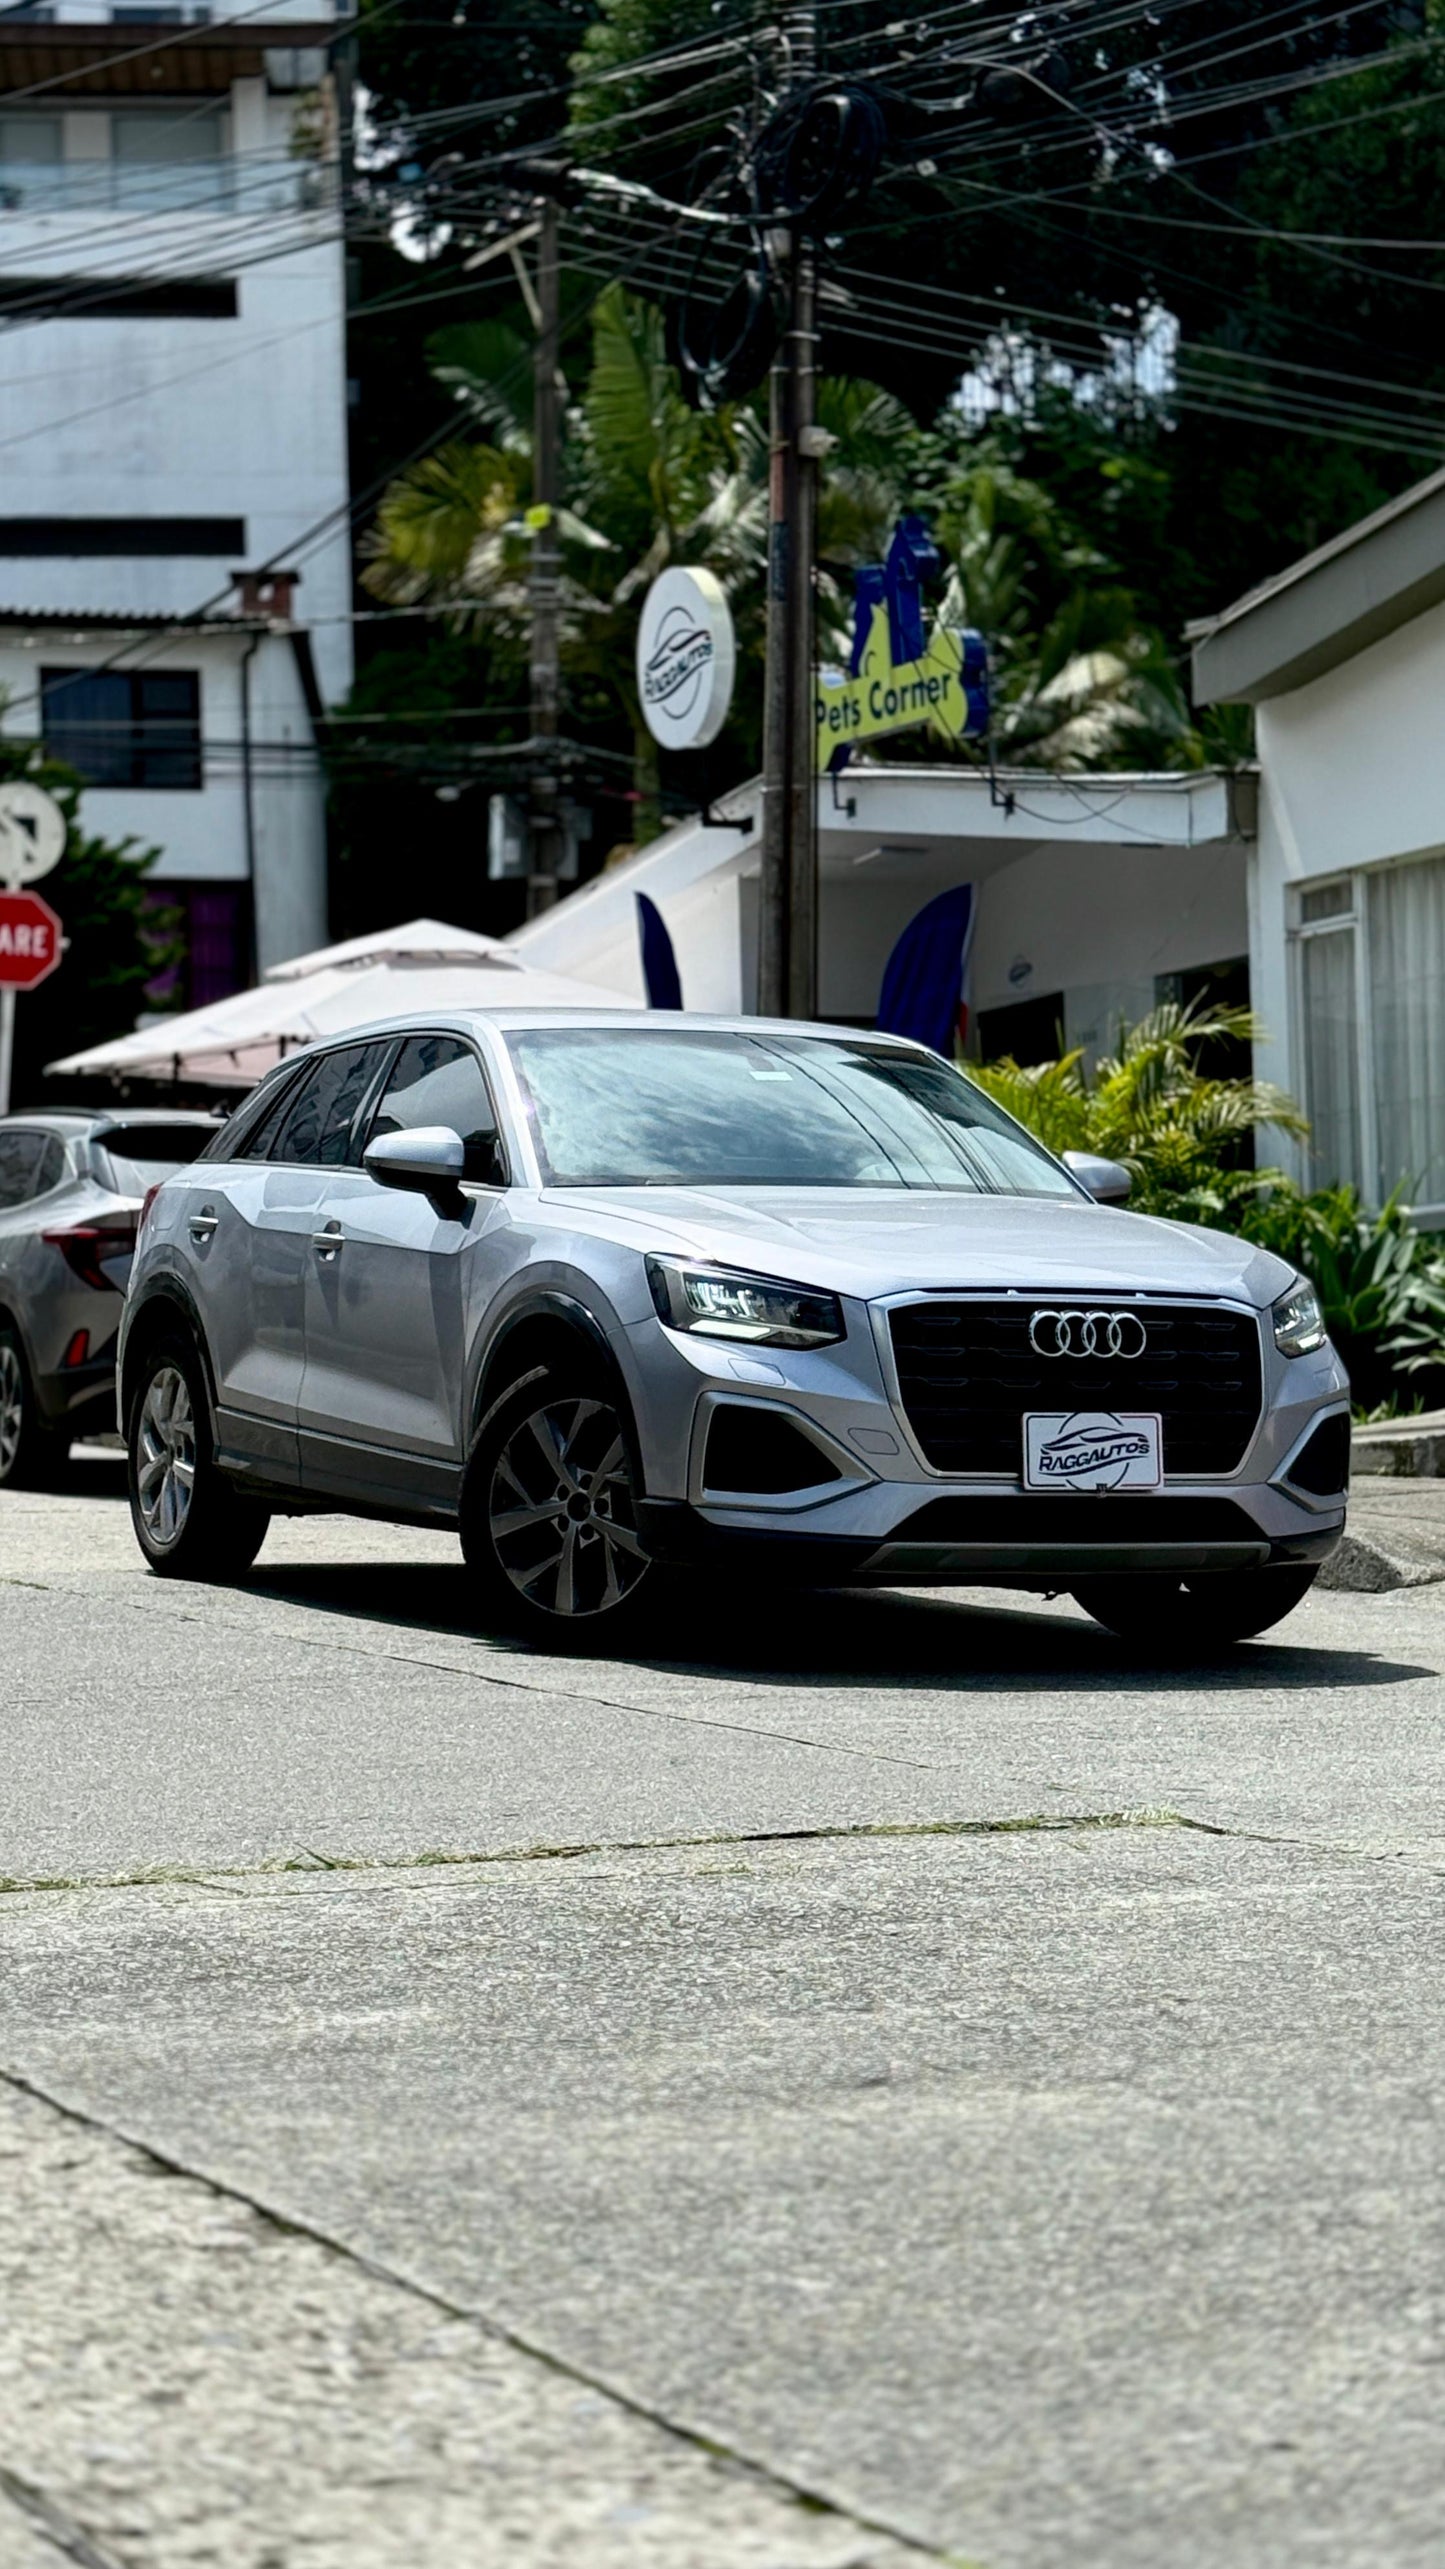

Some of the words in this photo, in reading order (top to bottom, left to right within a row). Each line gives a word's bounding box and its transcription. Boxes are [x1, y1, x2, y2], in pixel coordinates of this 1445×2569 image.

[815, 696, 861, 733] Pets
[869, 672, 951, 720] Corner
[1039, 1442, 1150, 1472] RAGGAUTOS
